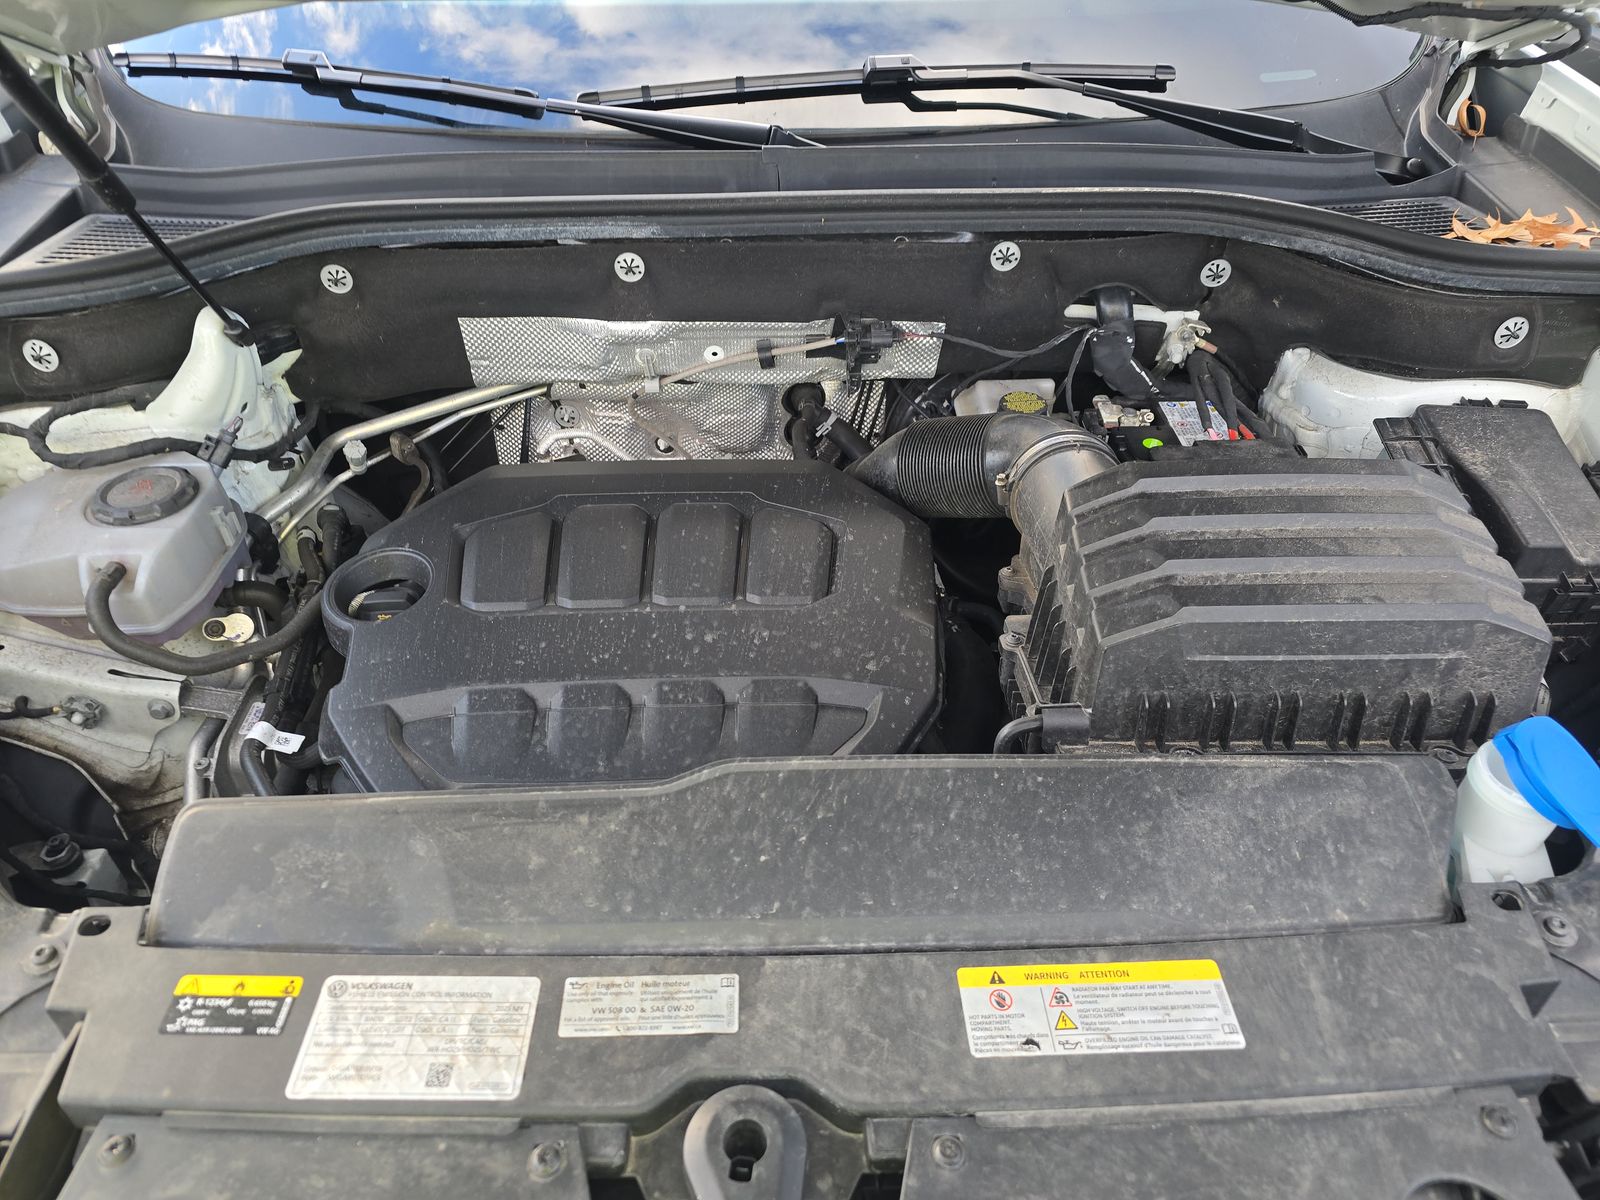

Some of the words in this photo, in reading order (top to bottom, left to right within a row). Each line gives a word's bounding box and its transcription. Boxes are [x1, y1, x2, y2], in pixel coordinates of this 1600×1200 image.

[1024, 971, 1069, 980] WARNING
[1079, 969, 1130, 979] ATTENTION
[350, 982, 413, 990] VOLKSWAGEN
[596, 982, 623, 991] Engine
[641, 980, 661, 988] Huile
[624, 1006, 637, 1014] 00
[650, 1005, 665, 1013] SAE
[667, 1004, 695, 1012] 0W-20
